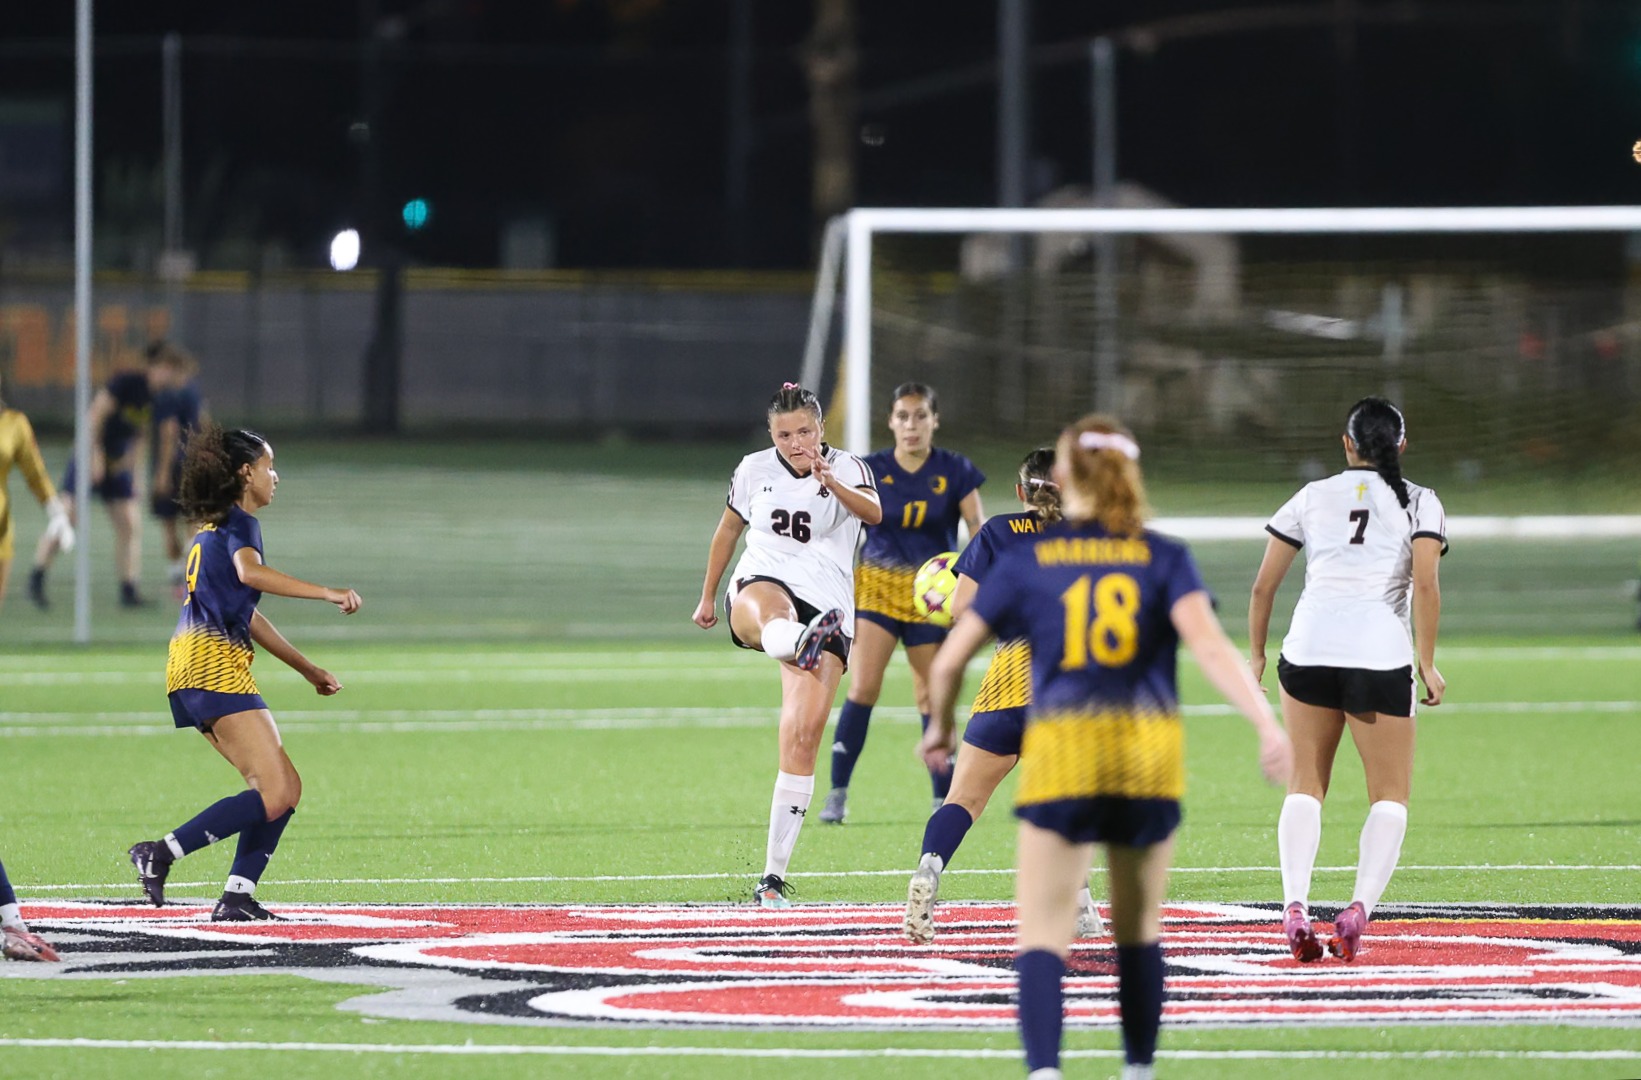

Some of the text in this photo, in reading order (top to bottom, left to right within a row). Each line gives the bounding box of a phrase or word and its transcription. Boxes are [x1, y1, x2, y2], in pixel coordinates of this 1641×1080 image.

[771, 509, 811, 543] 26
[902, 500, 927, 528] 17
[1349, 509, 1369, 544] 7
[1060, 573, 1141, 671] 18
